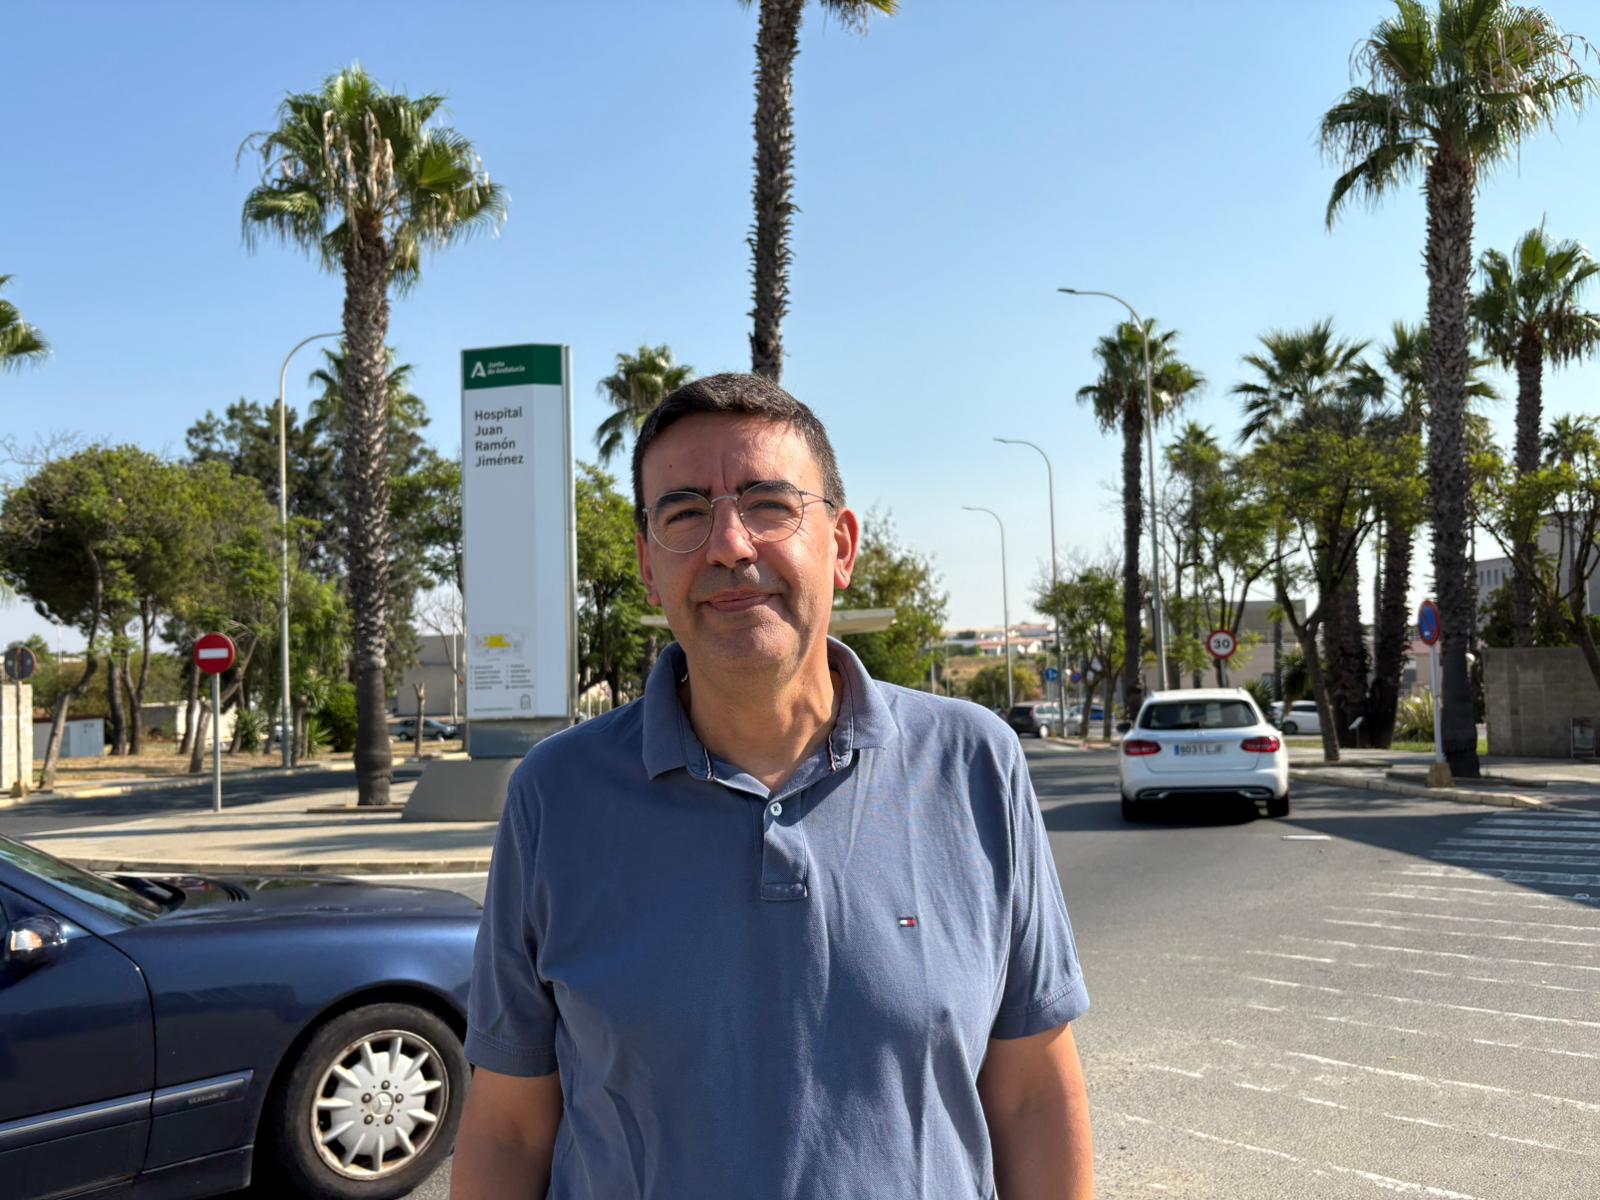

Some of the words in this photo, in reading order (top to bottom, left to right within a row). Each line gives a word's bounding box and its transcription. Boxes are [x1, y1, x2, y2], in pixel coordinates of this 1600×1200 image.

[474, 406, 523, 422] Hospital
[475, 425, 503, 437] Juan
[475, 436, 516, 451] Ramón
[475, 452, 524, 467] Jiménez
[1213, 638, 1231, 650] 30
